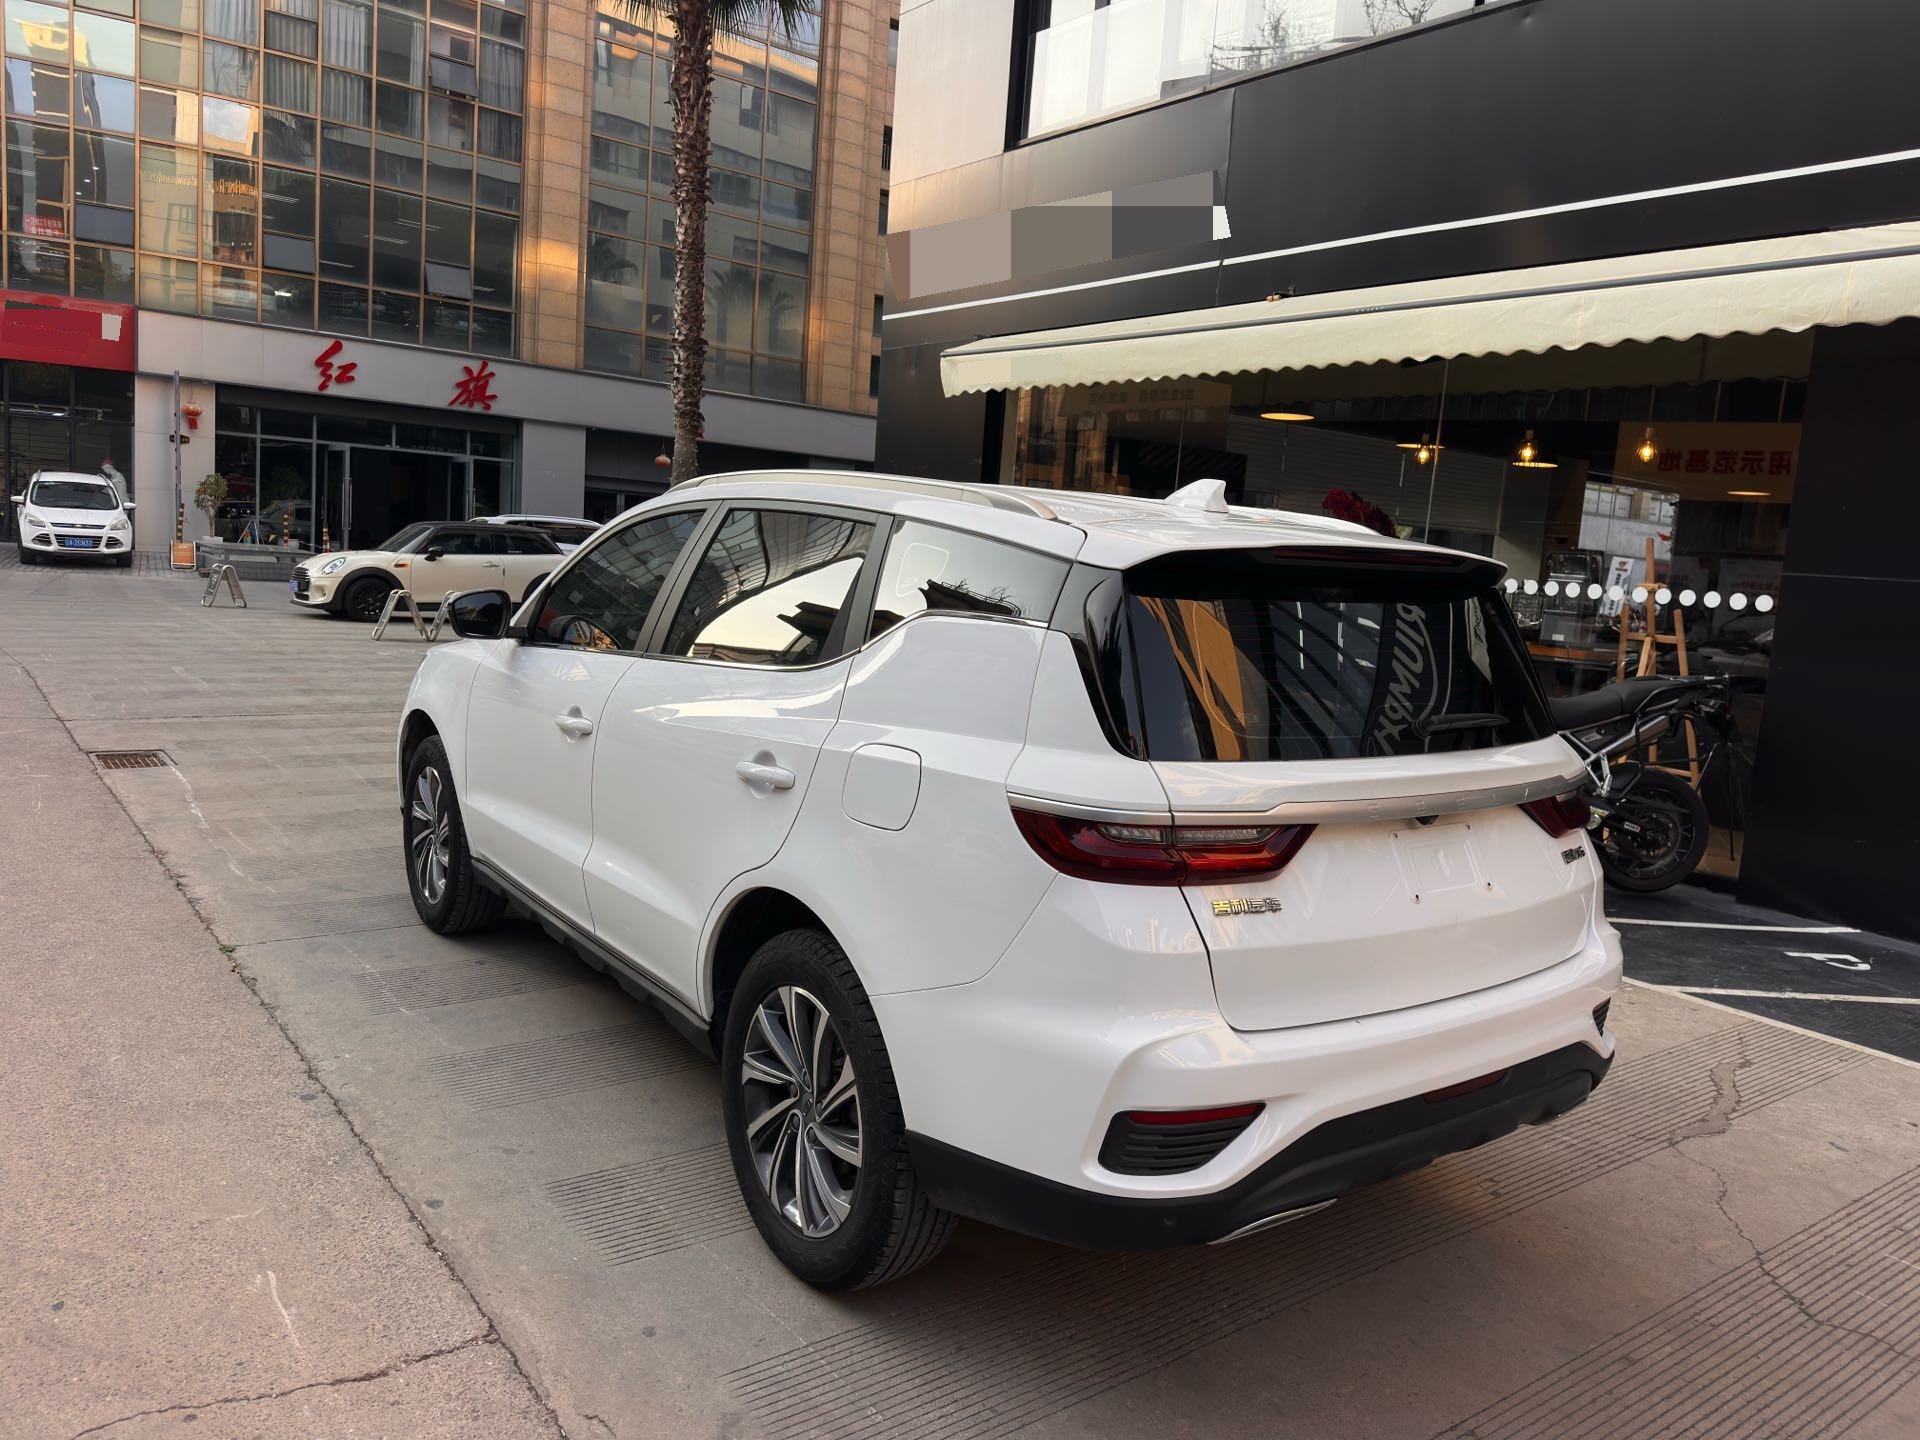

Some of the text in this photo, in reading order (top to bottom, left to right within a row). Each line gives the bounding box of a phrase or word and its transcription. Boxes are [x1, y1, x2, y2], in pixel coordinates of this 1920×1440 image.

[315, 340, 498, 411] 红旗
[1211, 898, 1282, 916] 吉利汽车
